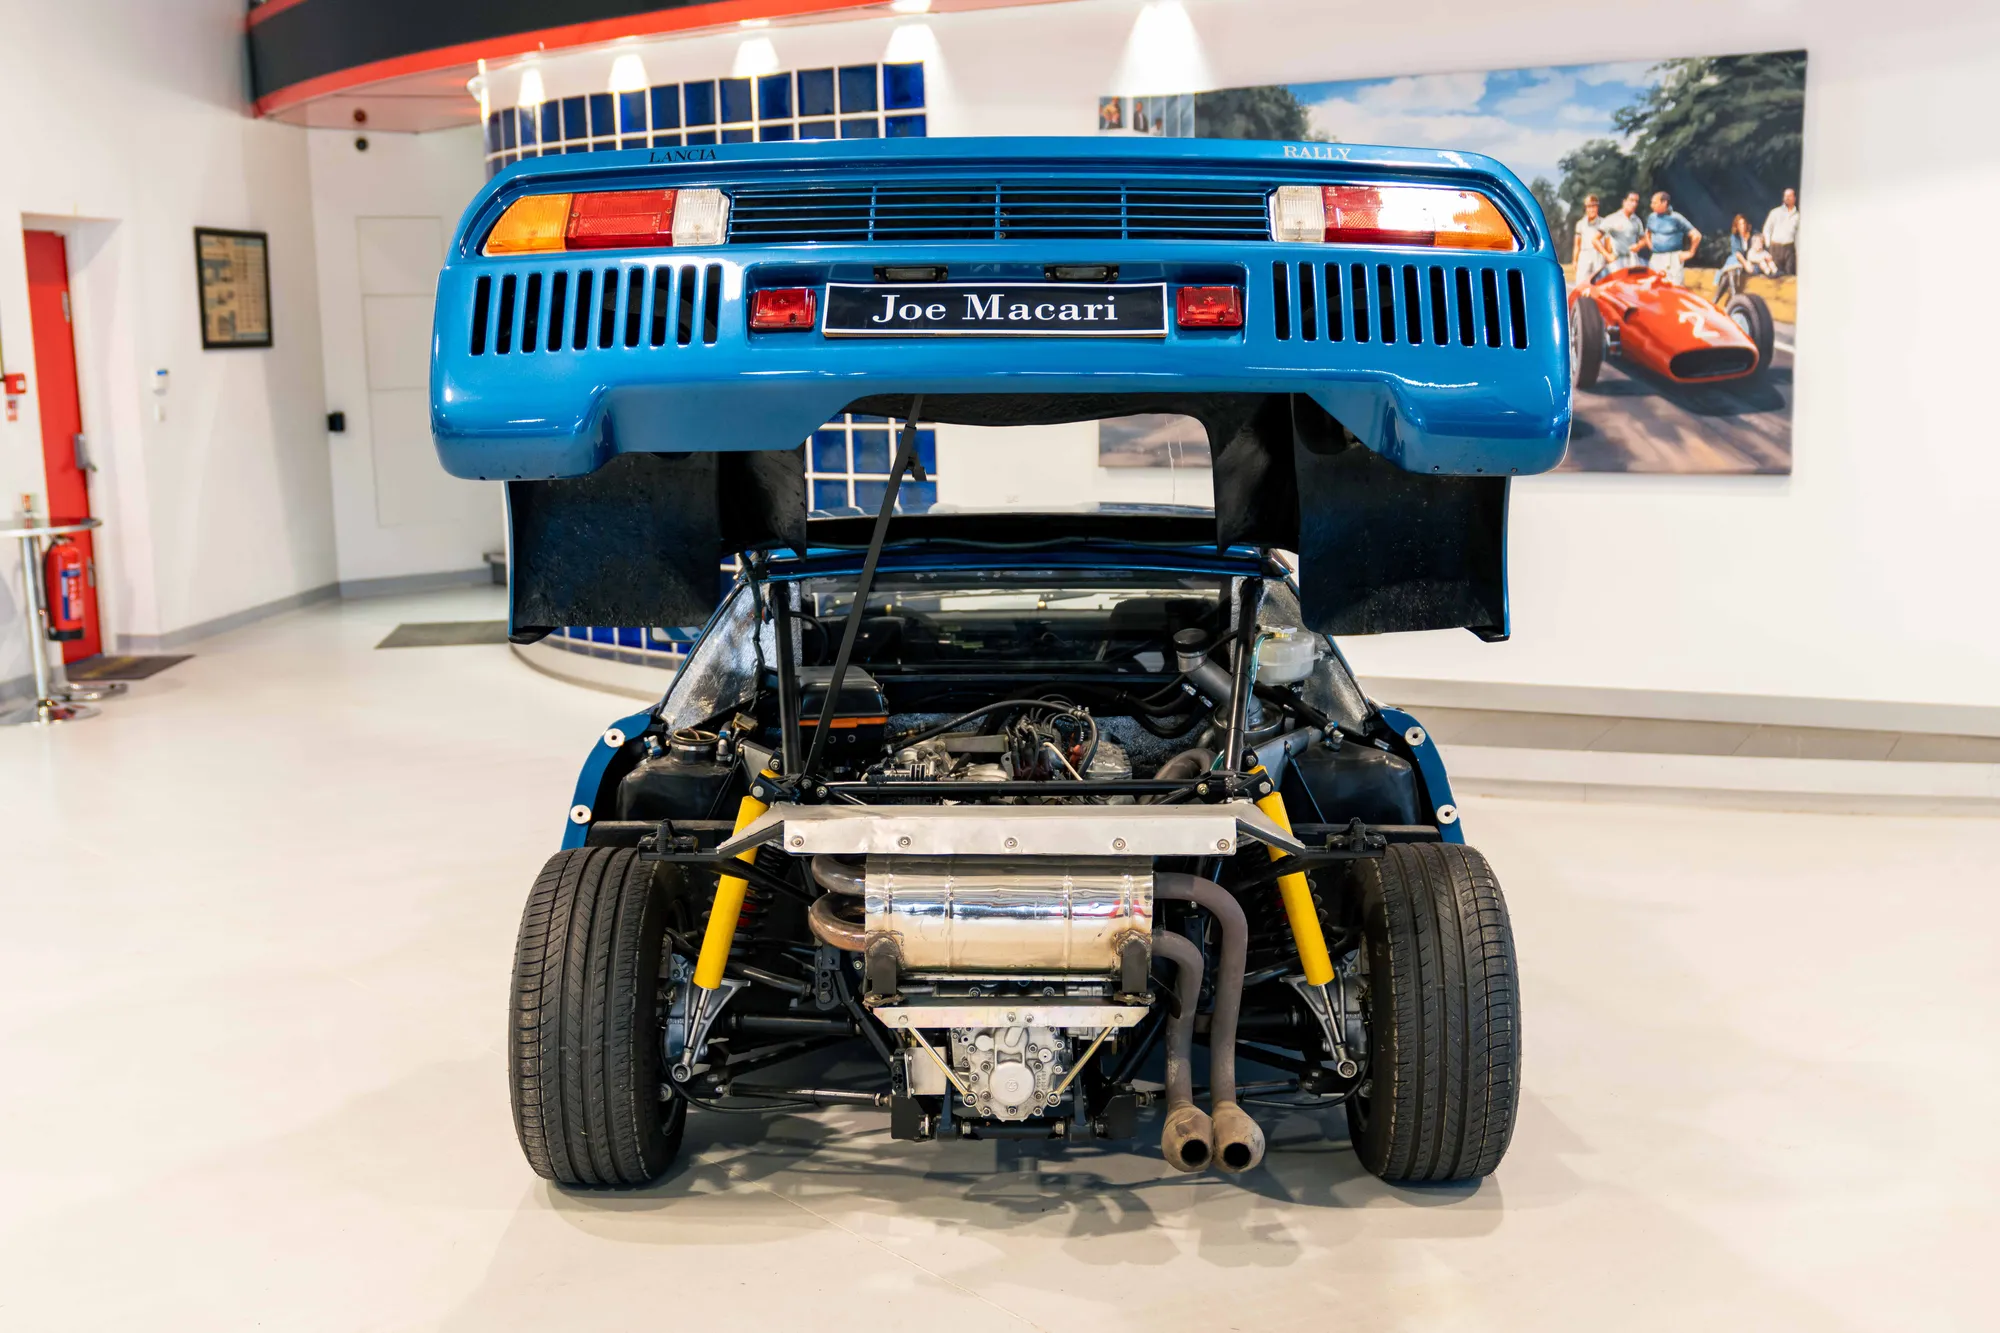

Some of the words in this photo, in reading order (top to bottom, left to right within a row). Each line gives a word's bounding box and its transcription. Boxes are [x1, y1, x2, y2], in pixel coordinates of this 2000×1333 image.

[649, 149, 717, 163] LANCIA
[1283, 145, 1352, 160] RALLY
[872, 294, 946, 323] Joe
[962, 294, 1118, 321] Macari
